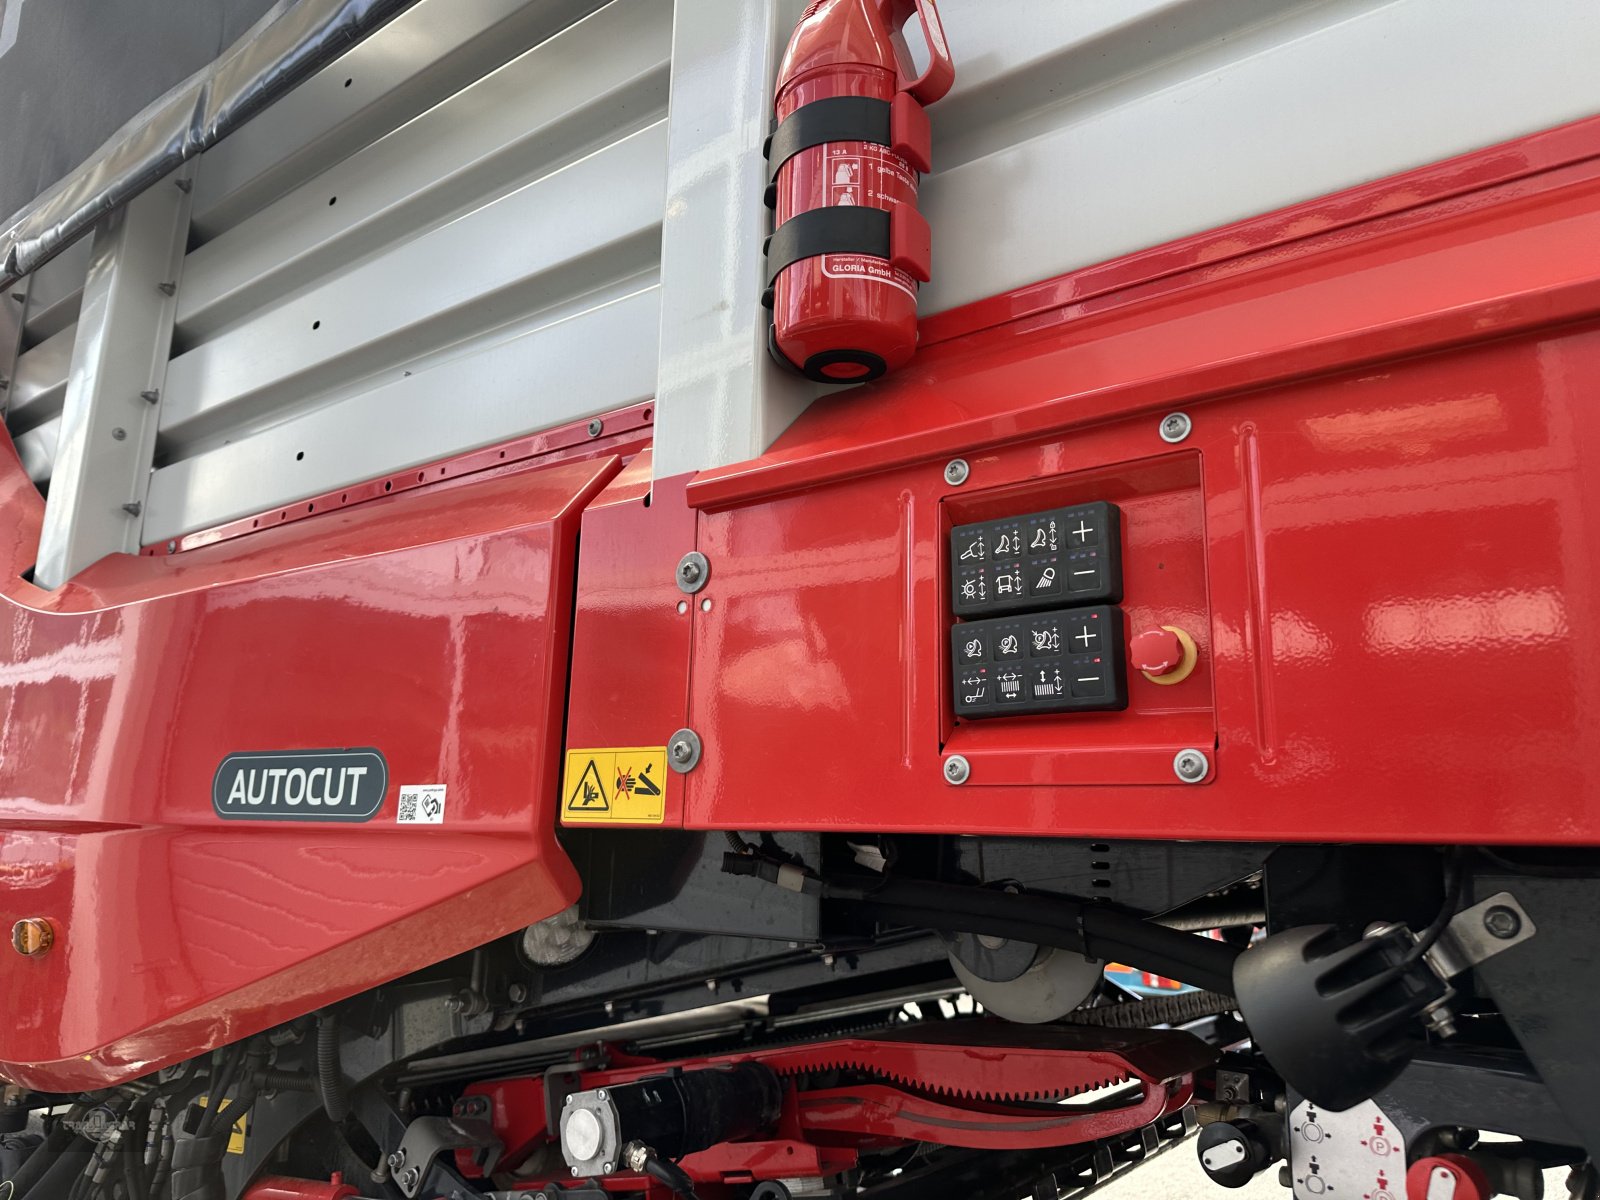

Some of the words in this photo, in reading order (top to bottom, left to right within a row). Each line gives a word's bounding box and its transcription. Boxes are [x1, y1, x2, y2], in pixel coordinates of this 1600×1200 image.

[877, 166, 895, 177] gelbe
[896, 171, 910, 186] Taste
[868, 189, 873, 197] 2
[876, 192, 900, 204] schwar
[832, 264, 866, 273] GLORIA
[867, 266, 891, 278] GmbH
[226, 766, 368, 806] AUTOCUT
